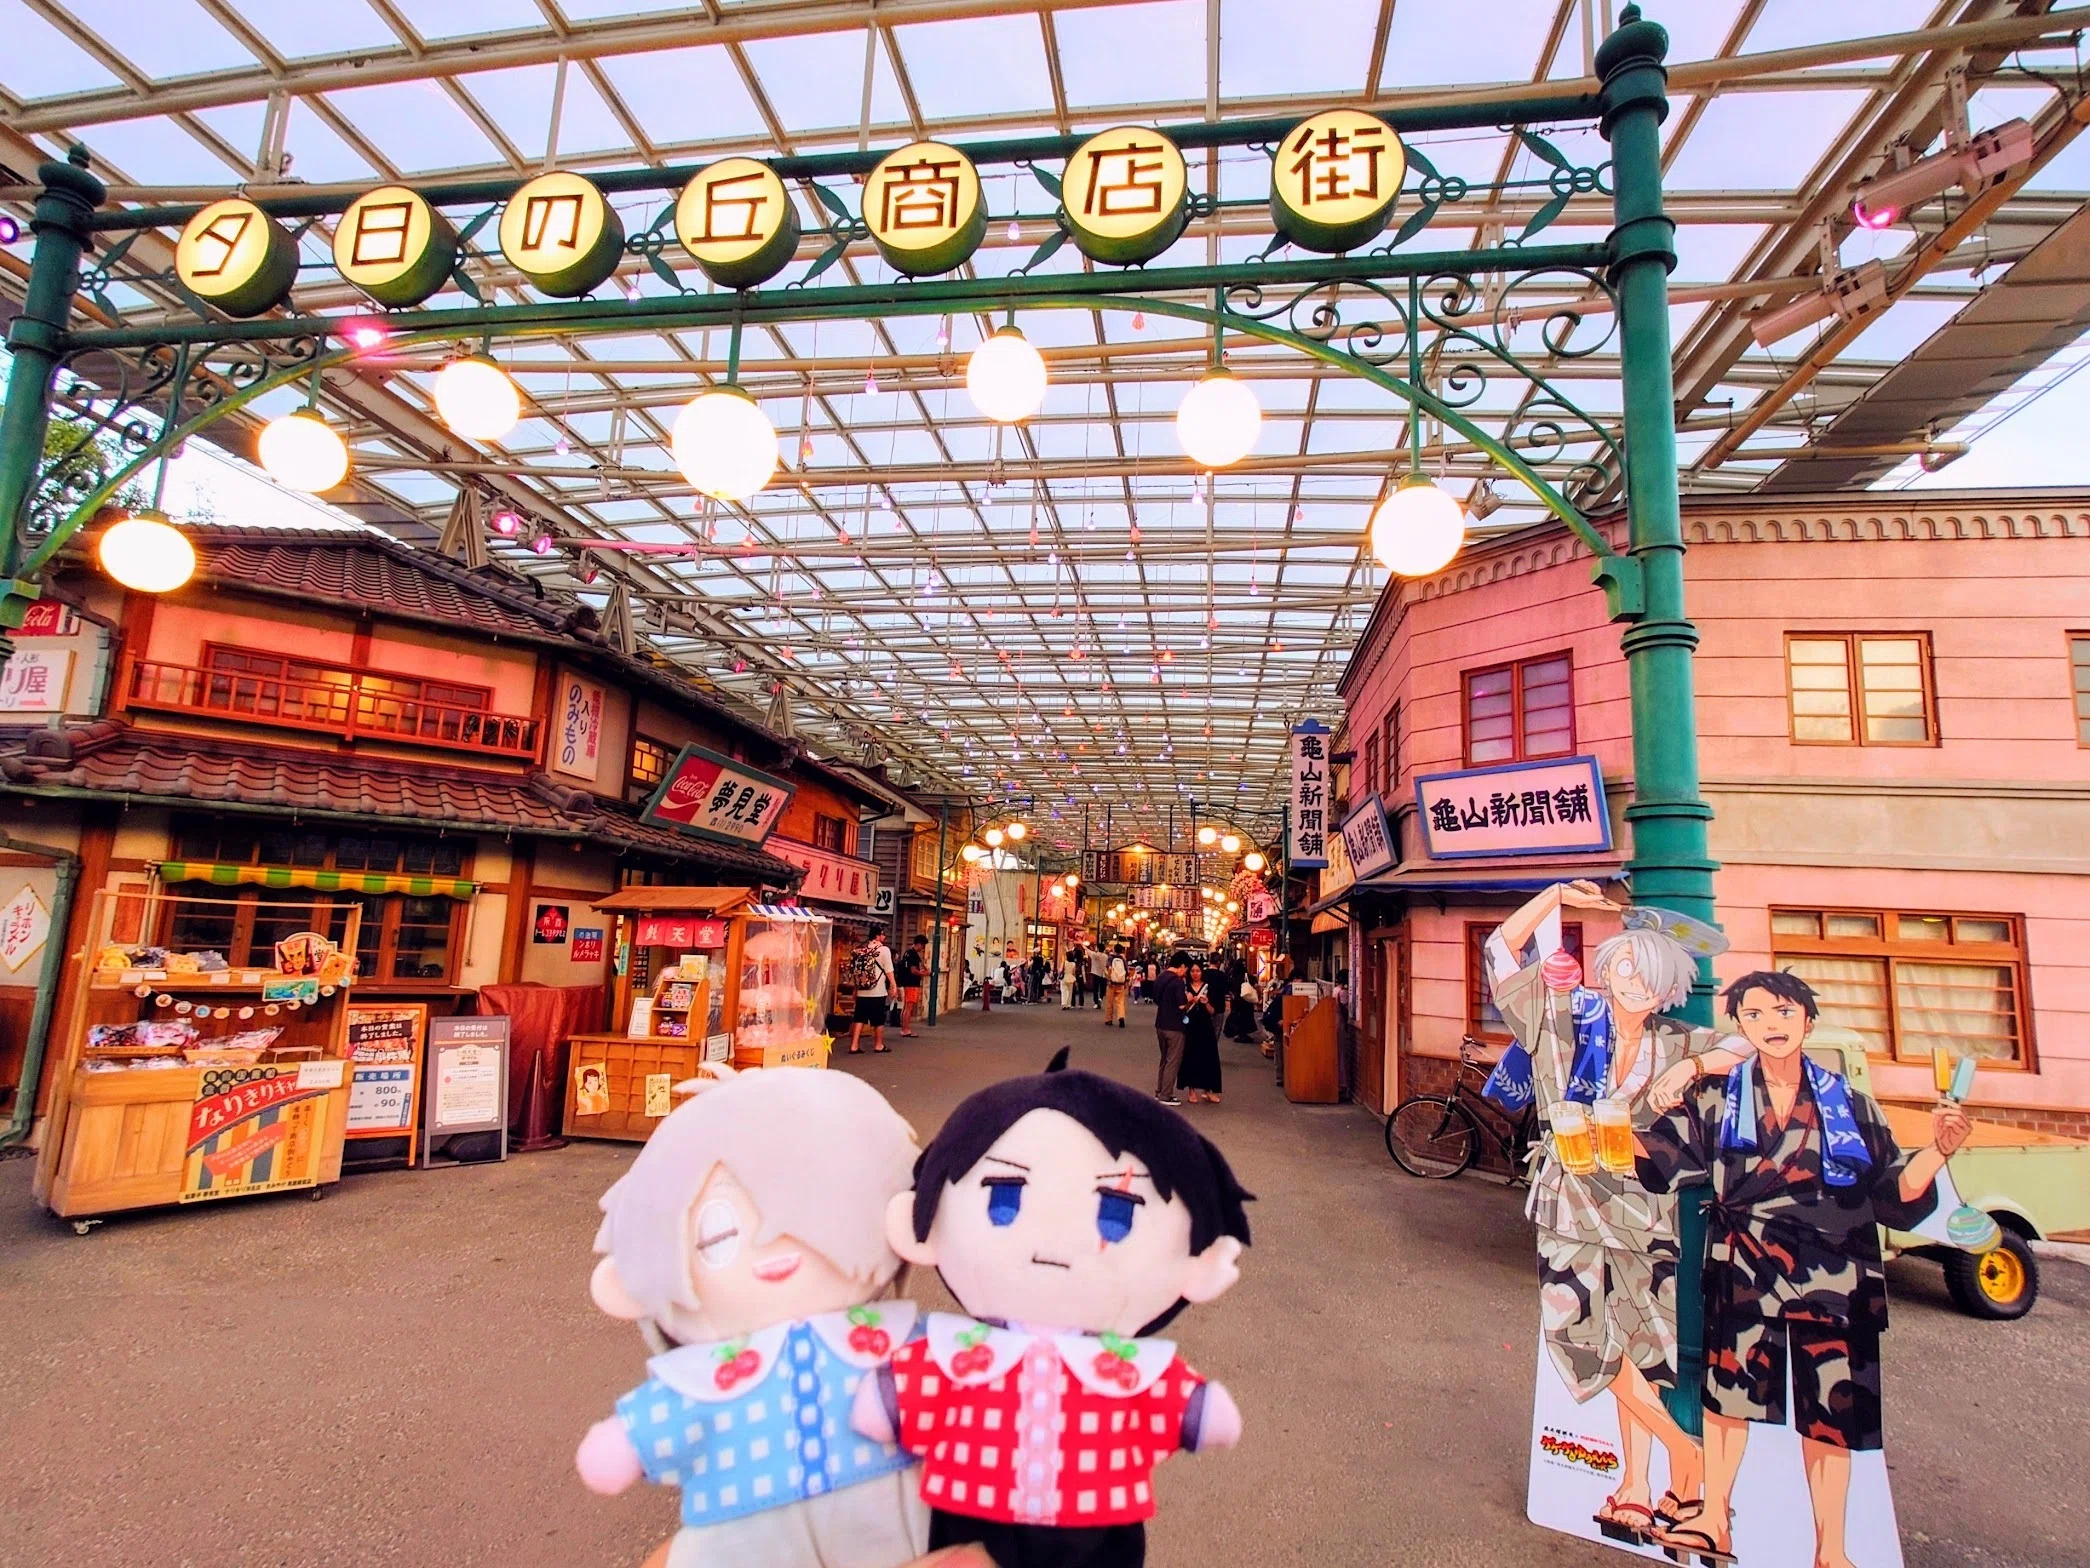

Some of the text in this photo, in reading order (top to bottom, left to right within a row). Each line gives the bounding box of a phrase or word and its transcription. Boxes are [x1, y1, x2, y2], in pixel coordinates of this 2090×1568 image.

[191, 127, 1388, 277] 夕日の丘商店街
[563, 685, 582, 766] のみもの
[709, 780, 773, 826] 夢見堂
